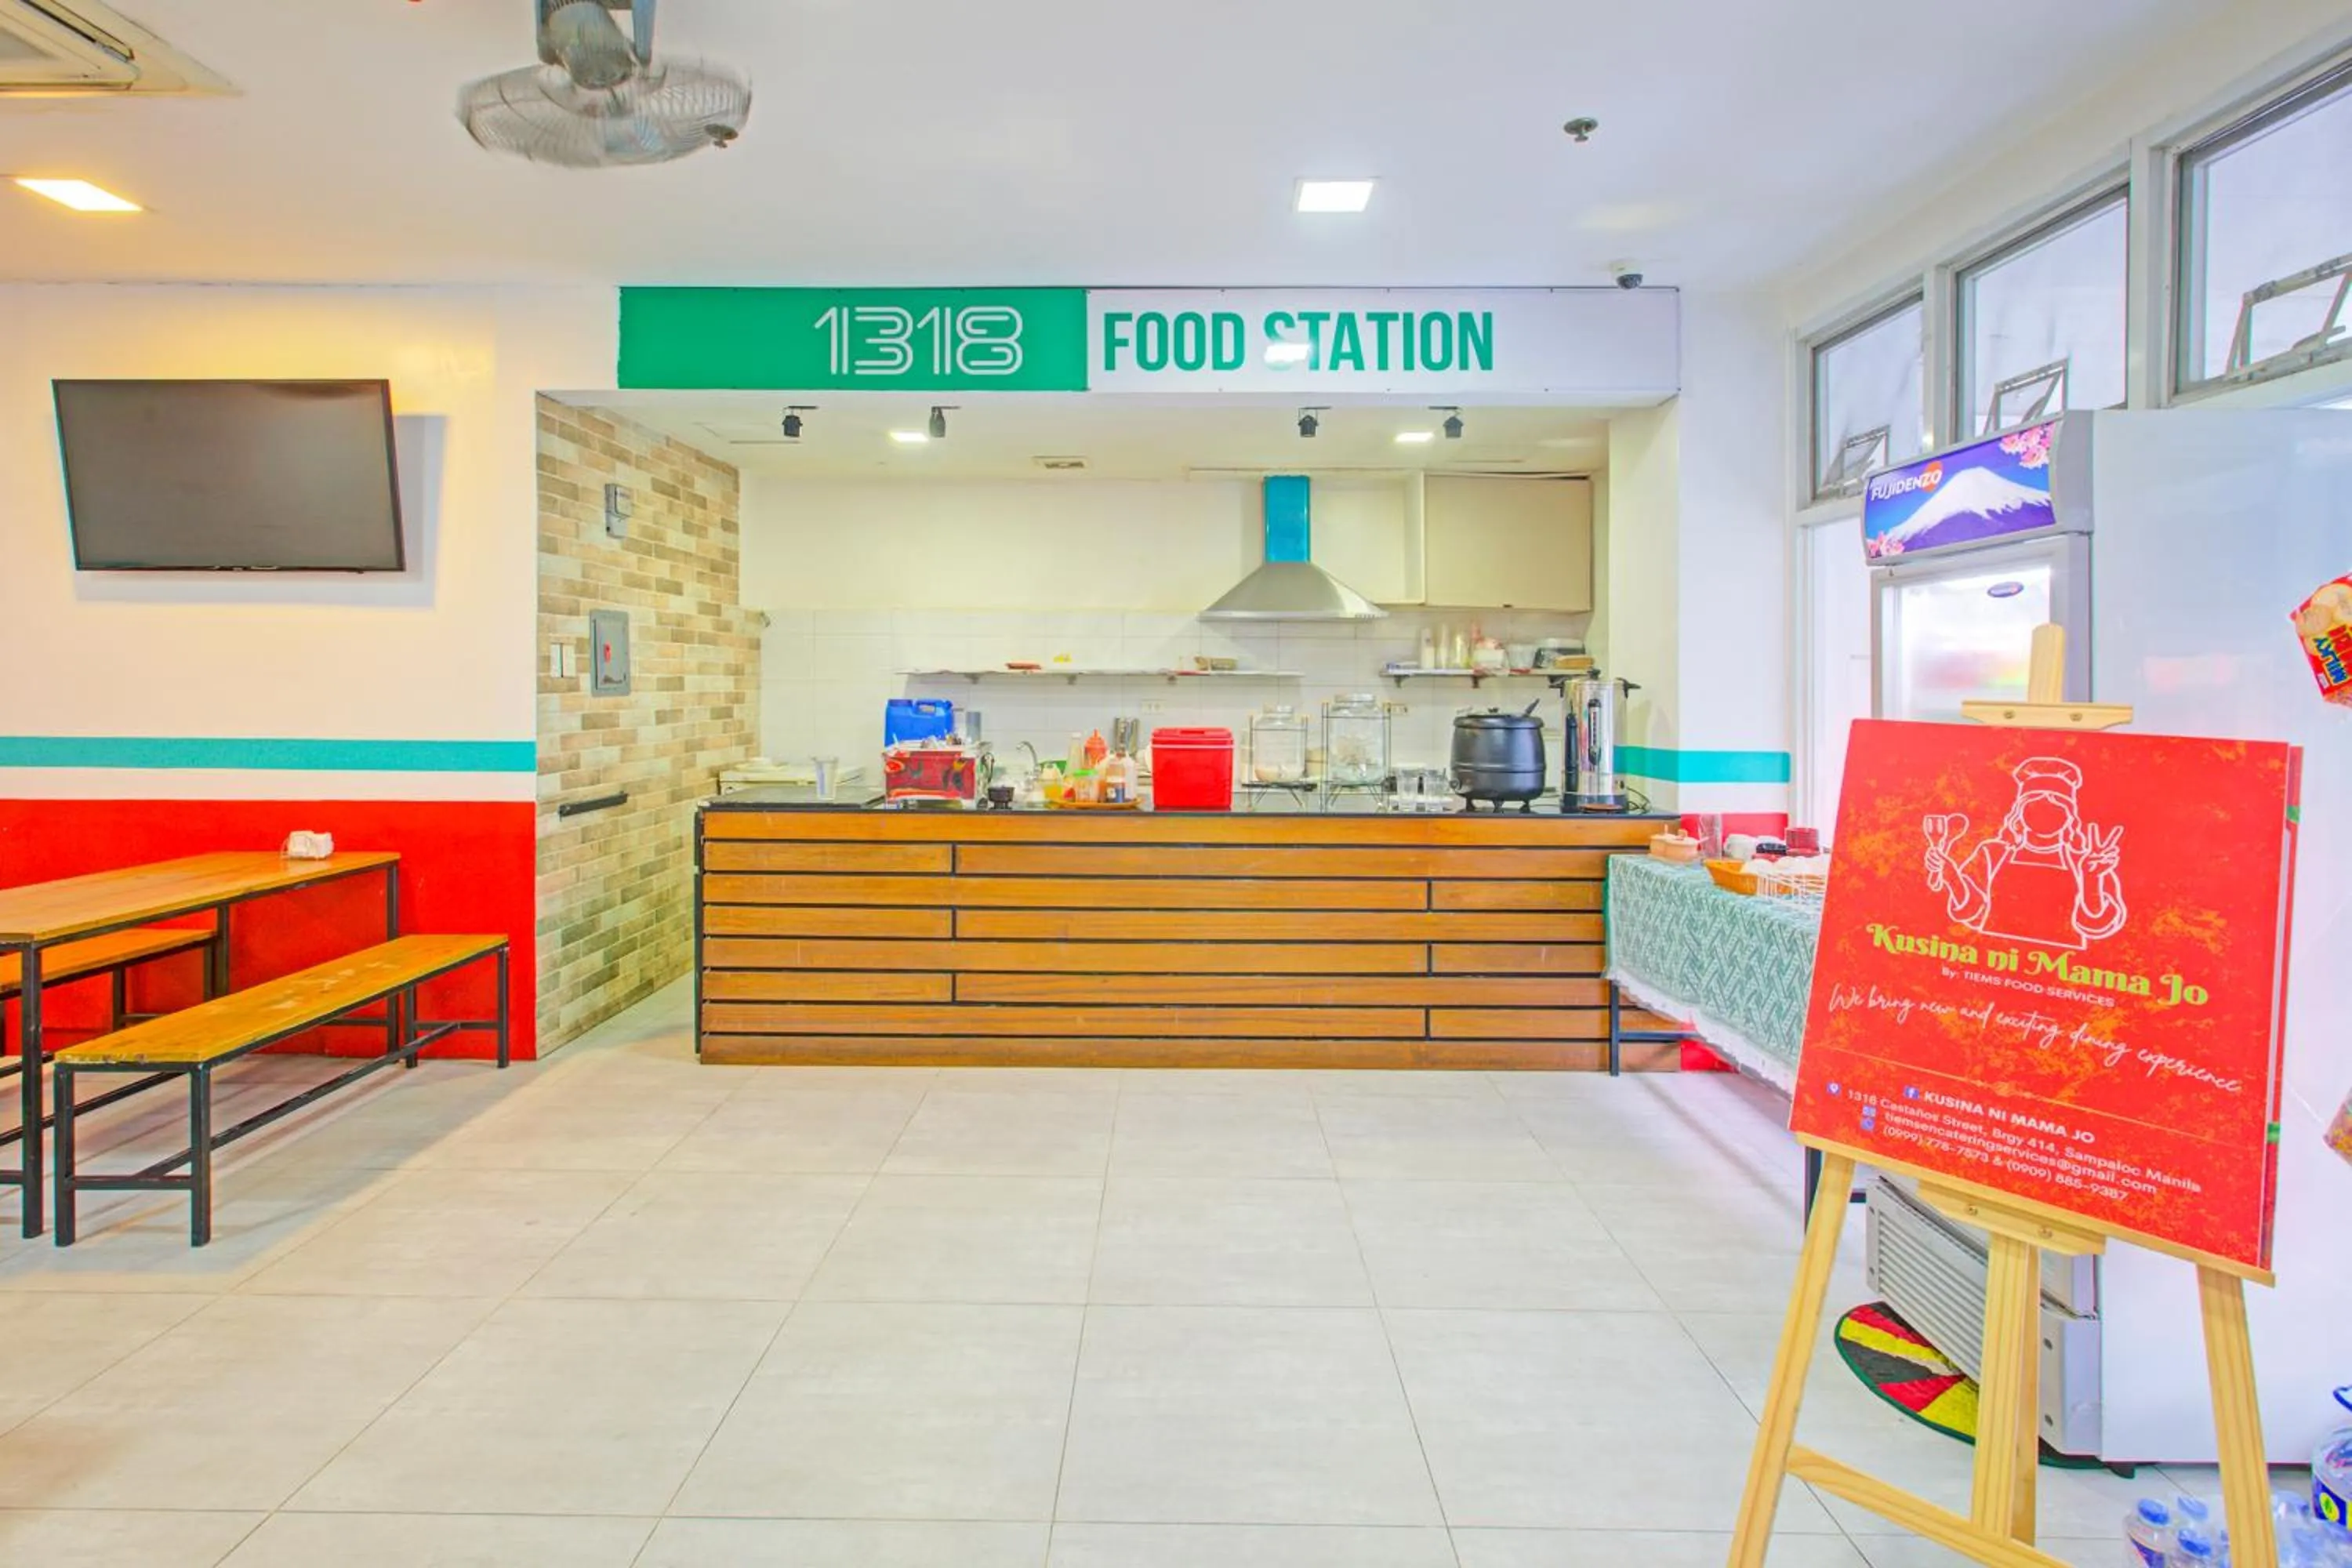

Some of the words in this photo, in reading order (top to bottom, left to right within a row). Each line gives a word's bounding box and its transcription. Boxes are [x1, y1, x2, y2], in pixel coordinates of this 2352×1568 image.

[814, 307, 1023, 376] 1318
[1103, 311, 1246, 372] FOOD
[1263, 311, 1494, 372] STATION
[1871, 469, 1942, 502] FUJIDENZO
[2313, 637, 2348, 684] MILKY
[1866, 923, 1979, 964] Kusina
[1987, 948, 2020, 971] ni
[2023, 951, 2151, 996] Mama
[2157, 974, 2209, 1006] Jo
[2005, 978, 2043, 994] FOOD
[2046, 986, 2115, 1008] SERVICES
[1829, 983, 1864, 1012] We
[1867, 985, 1915, 1025] bring
[1920, 1001, 1957, 1015] new
[1961, 1001, 1995, 1029] and
[1996, 1010, 2064, 1050] exciting
[2070, 1022, 2132, 1067] dining
[2137, 1048, 2242, 1092] experience
[1924, 1091, 1984, 1116] KUSINA
[1987, 1106, 2007, 1121] NI
[2010, 1113, 2067, 1137] MAMA
[2072, 1129, 2096, 1144] JO
[1992, 1127, 2024, 1147] Brgy
[2064, 1146, 2141, 1175] Sampaloc
[2145, 1167, 2201, 1192] Manila
